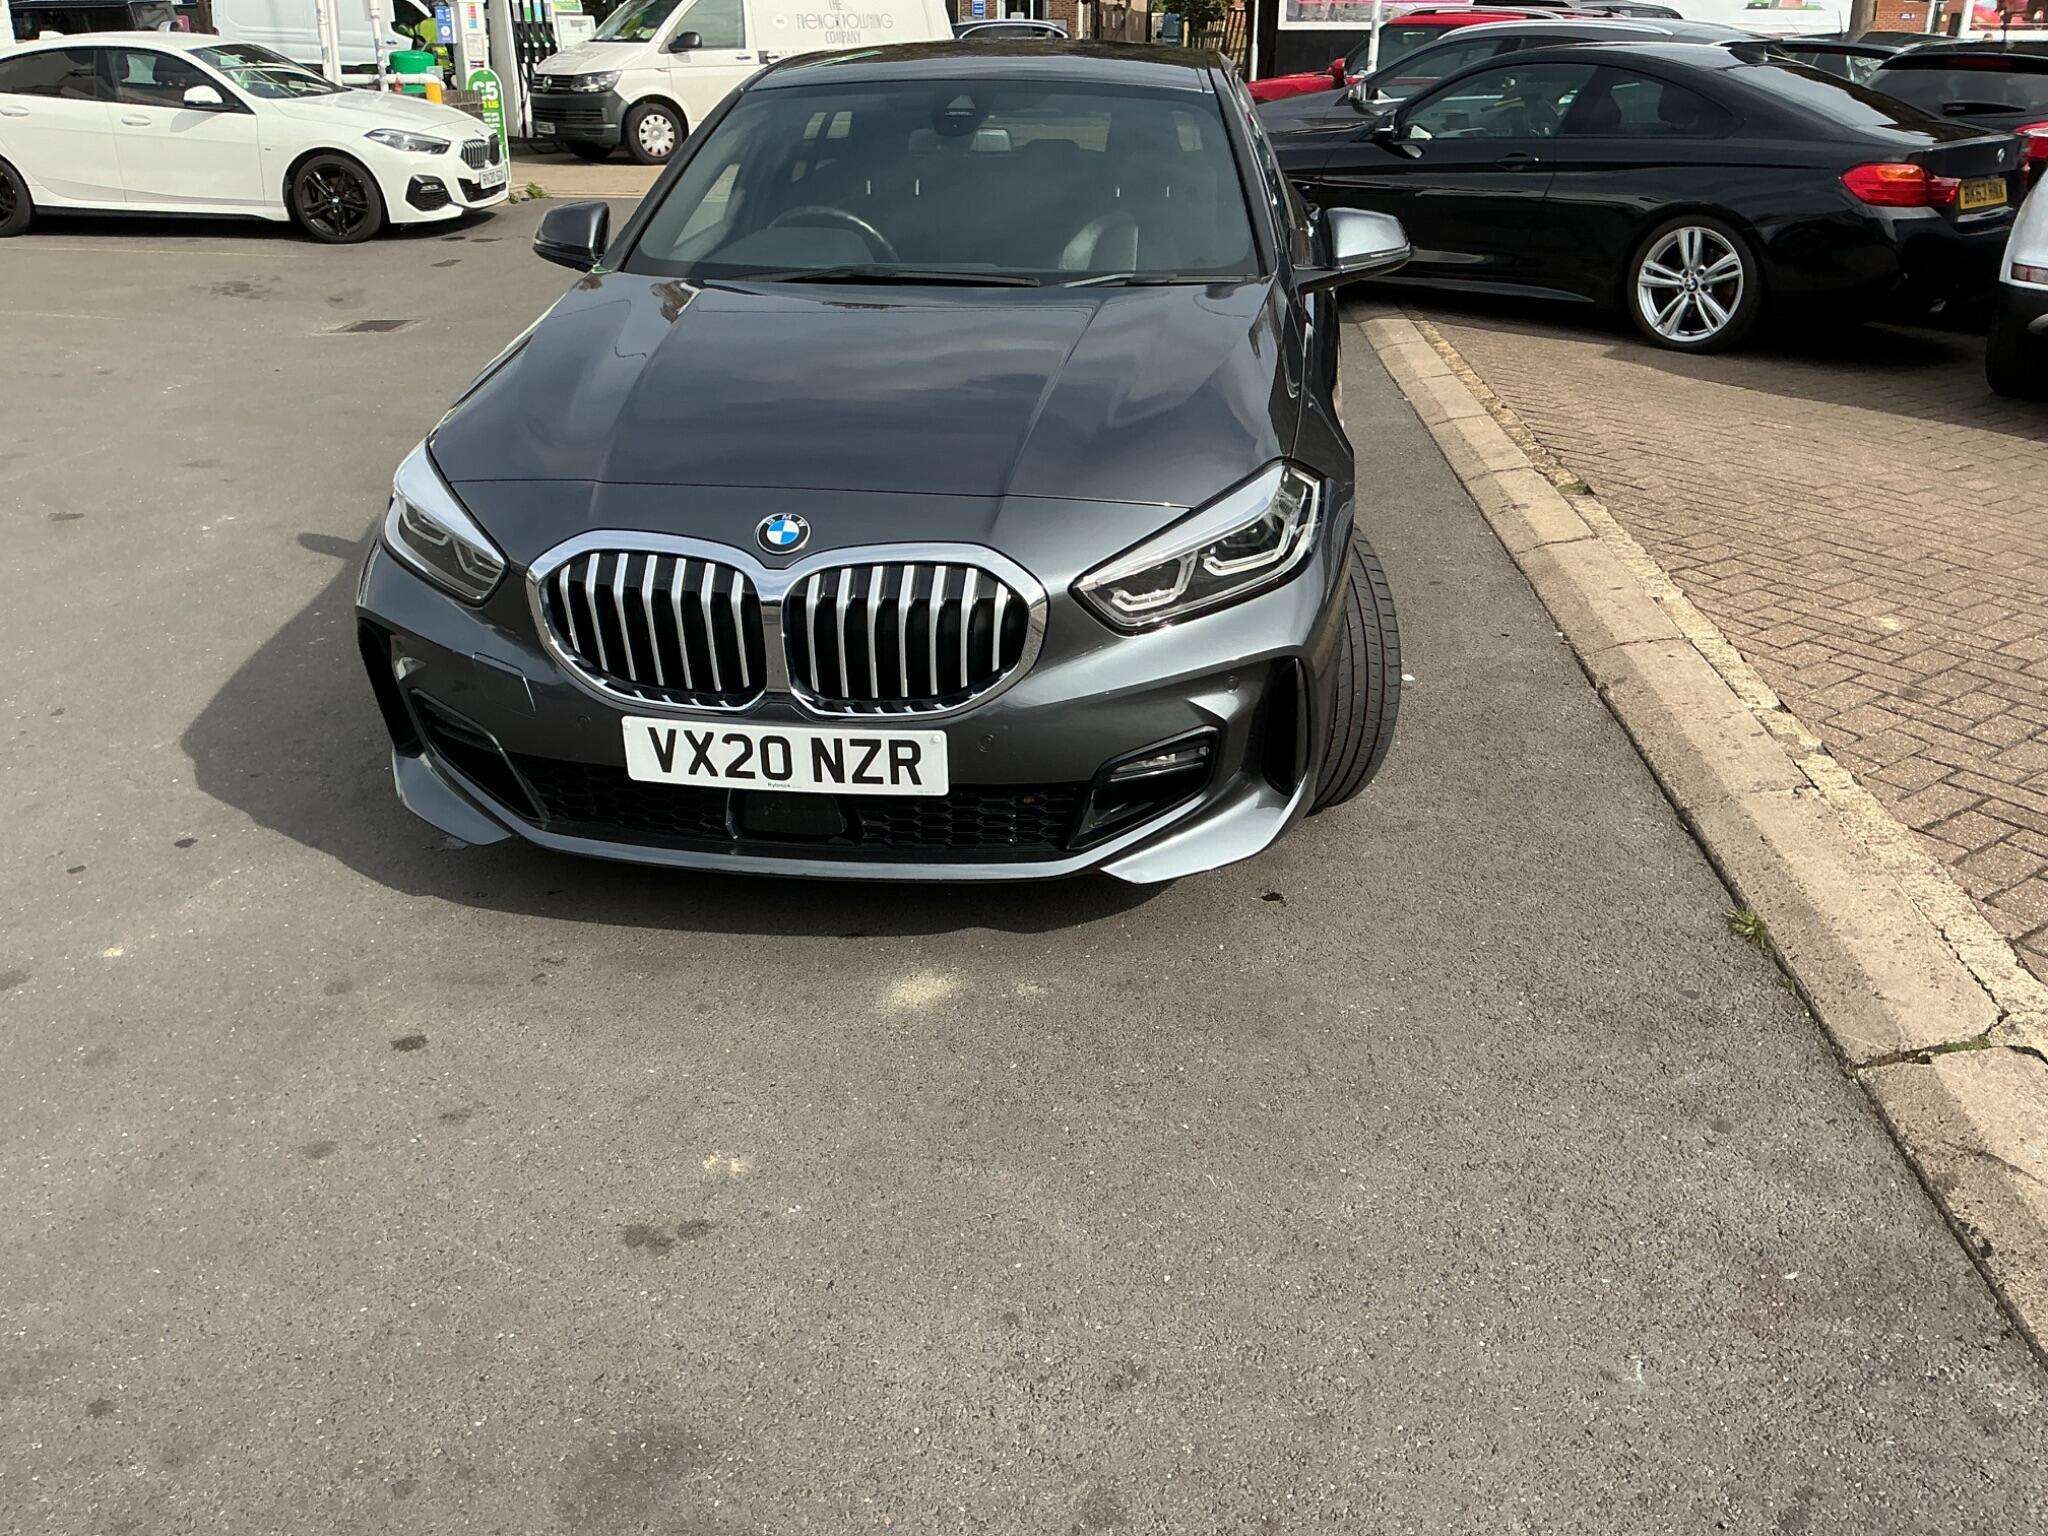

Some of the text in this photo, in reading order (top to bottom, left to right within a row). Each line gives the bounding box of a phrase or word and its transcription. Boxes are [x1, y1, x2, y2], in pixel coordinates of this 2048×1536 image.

[825, 31, 861, 45] COMPANY
[647, 727, 922, 785] VX20 NZR
